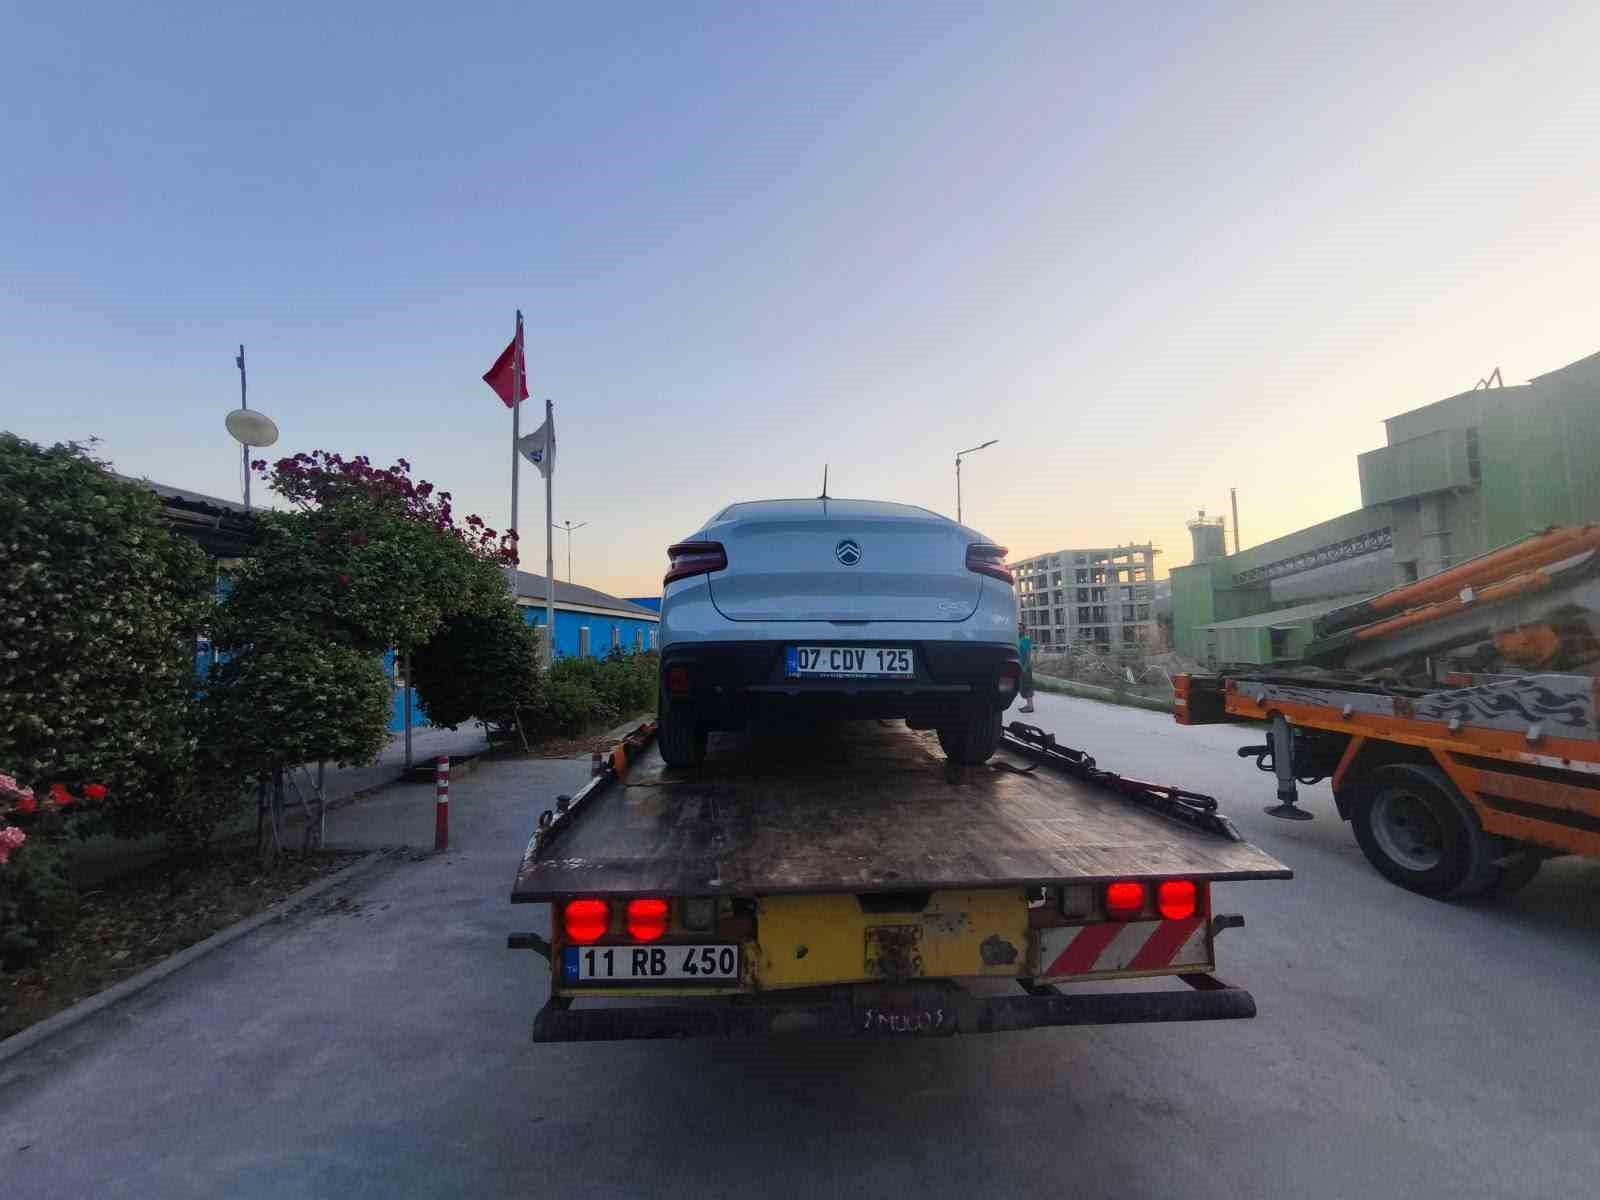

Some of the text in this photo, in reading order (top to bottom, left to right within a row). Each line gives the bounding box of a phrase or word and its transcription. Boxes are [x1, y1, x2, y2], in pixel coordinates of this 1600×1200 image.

[798, 648, 821, 671] 07
[830, 649, 865, 671] CDV
[876, 649, 910, 672] 125
[585, 947, 735, 977] 11 RB 450
